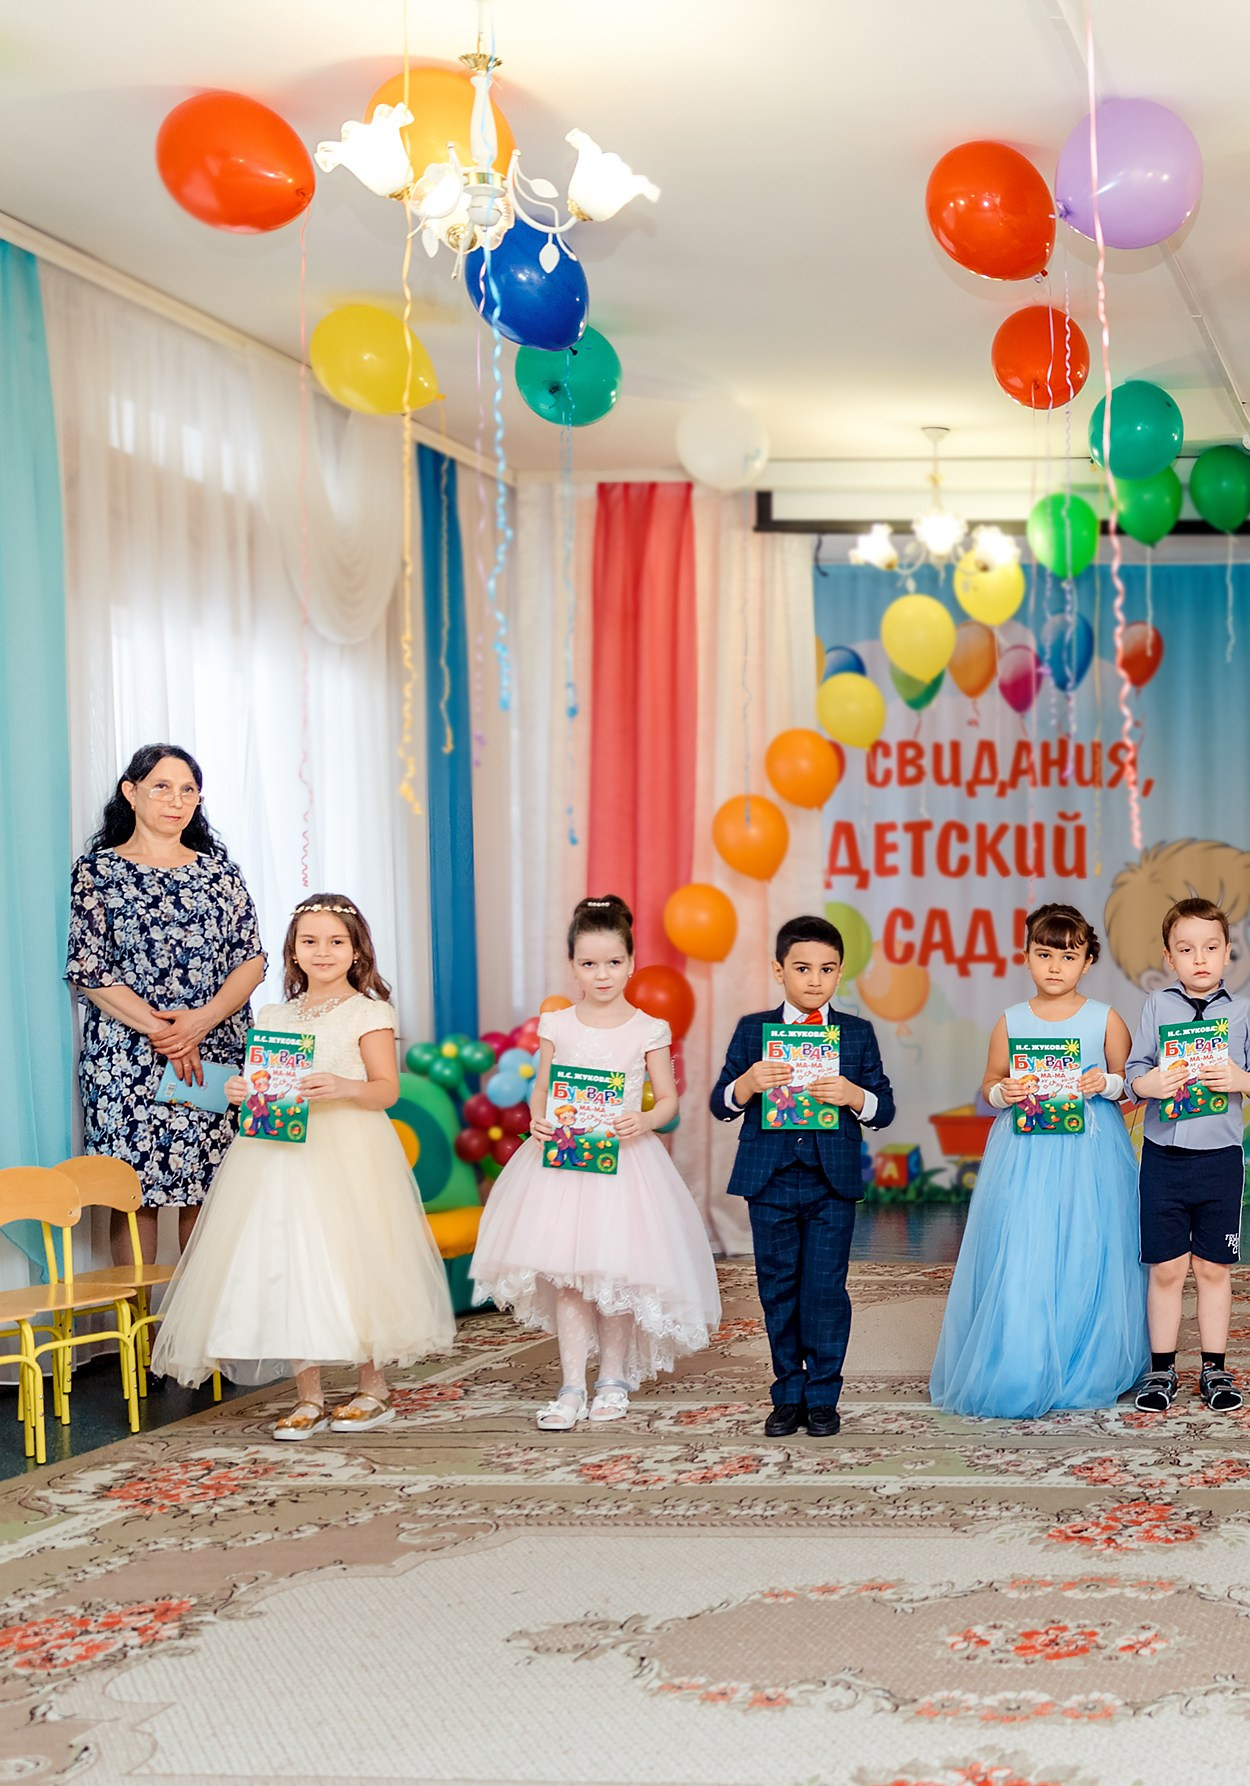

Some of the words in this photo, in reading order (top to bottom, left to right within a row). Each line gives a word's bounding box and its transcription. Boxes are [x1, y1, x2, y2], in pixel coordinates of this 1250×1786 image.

[865, 739, 1154, 798] СВИДАНИЯ,
[824, 811, 1087, 890] ДЕТСКИЙ
[883, 907, 1025, 979] САД!
[250, 1045, 312, 1068] БУКВАРЬ
[767, 1041, 839, 1061] БУКВАРЬ
[1164, 1037, 1228, 1058] БУКВАРЬ
[1013, 1054, 1080, 1073] БУКВАРЬ
[553, 1081, 622, 1105] БУКВАРЬ
